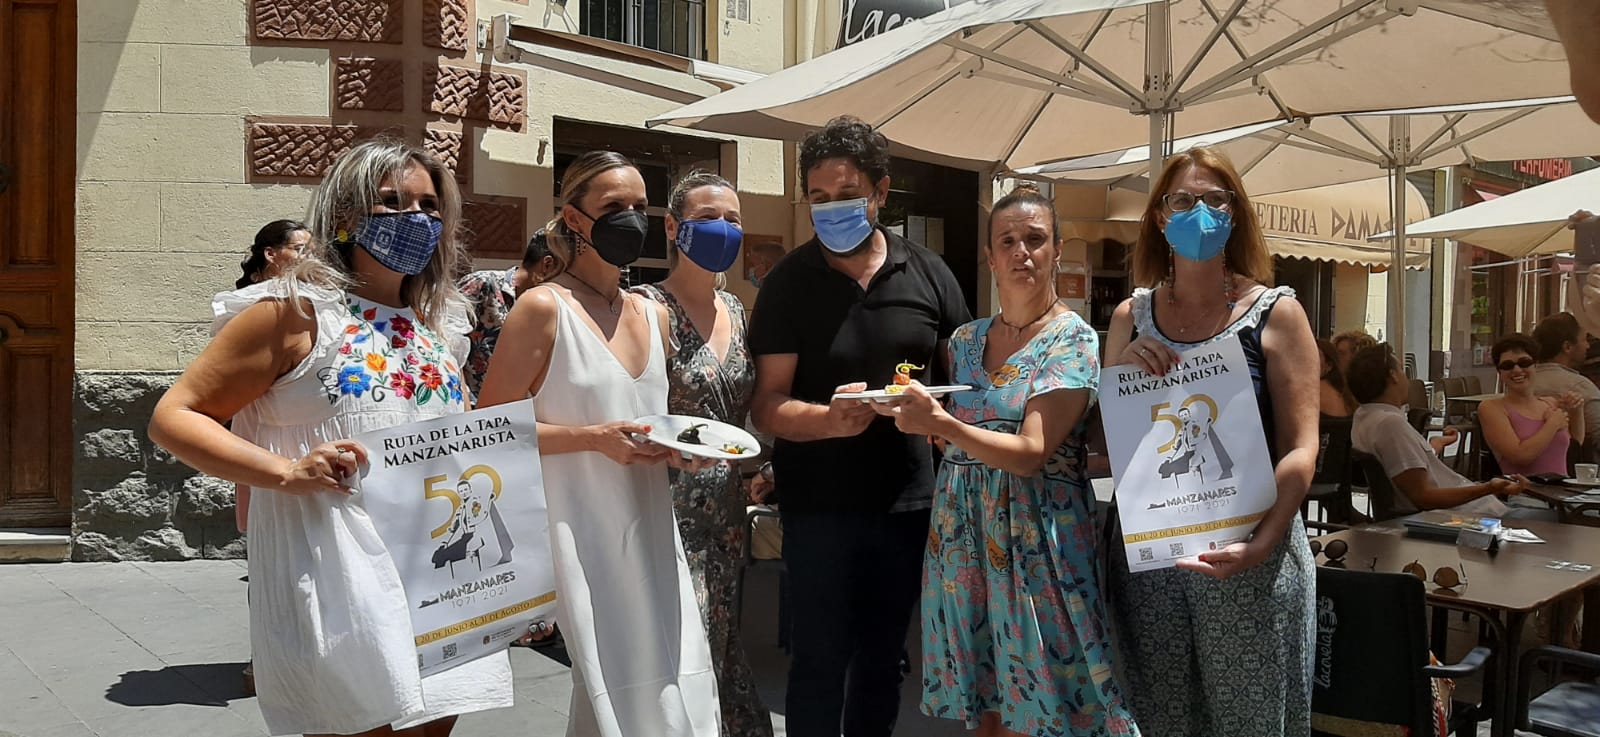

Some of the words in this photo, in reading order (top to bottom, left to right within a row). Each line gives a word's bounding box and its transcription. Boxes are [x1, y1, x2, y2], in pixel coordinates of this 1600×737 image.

[1250, 202, 1319, 236] ETERIA
[1175, 361, 1191, 373] LA
[1192, 352, 1224, 367] TAPA
[1118, 364, 1230, 397] MANZANARISTA
[383, 434, 426, 451] RUTA
[429, 428, 450, 441] DE
[454, 424, 473, 436] LA
[475, 416, 512, 431] TAPA
[384, 430, 516, 469] MANZANARISTA
[1166, 486, 1238, 507] MANZANARES
[439, 570, 516, 602] MANZANARES
